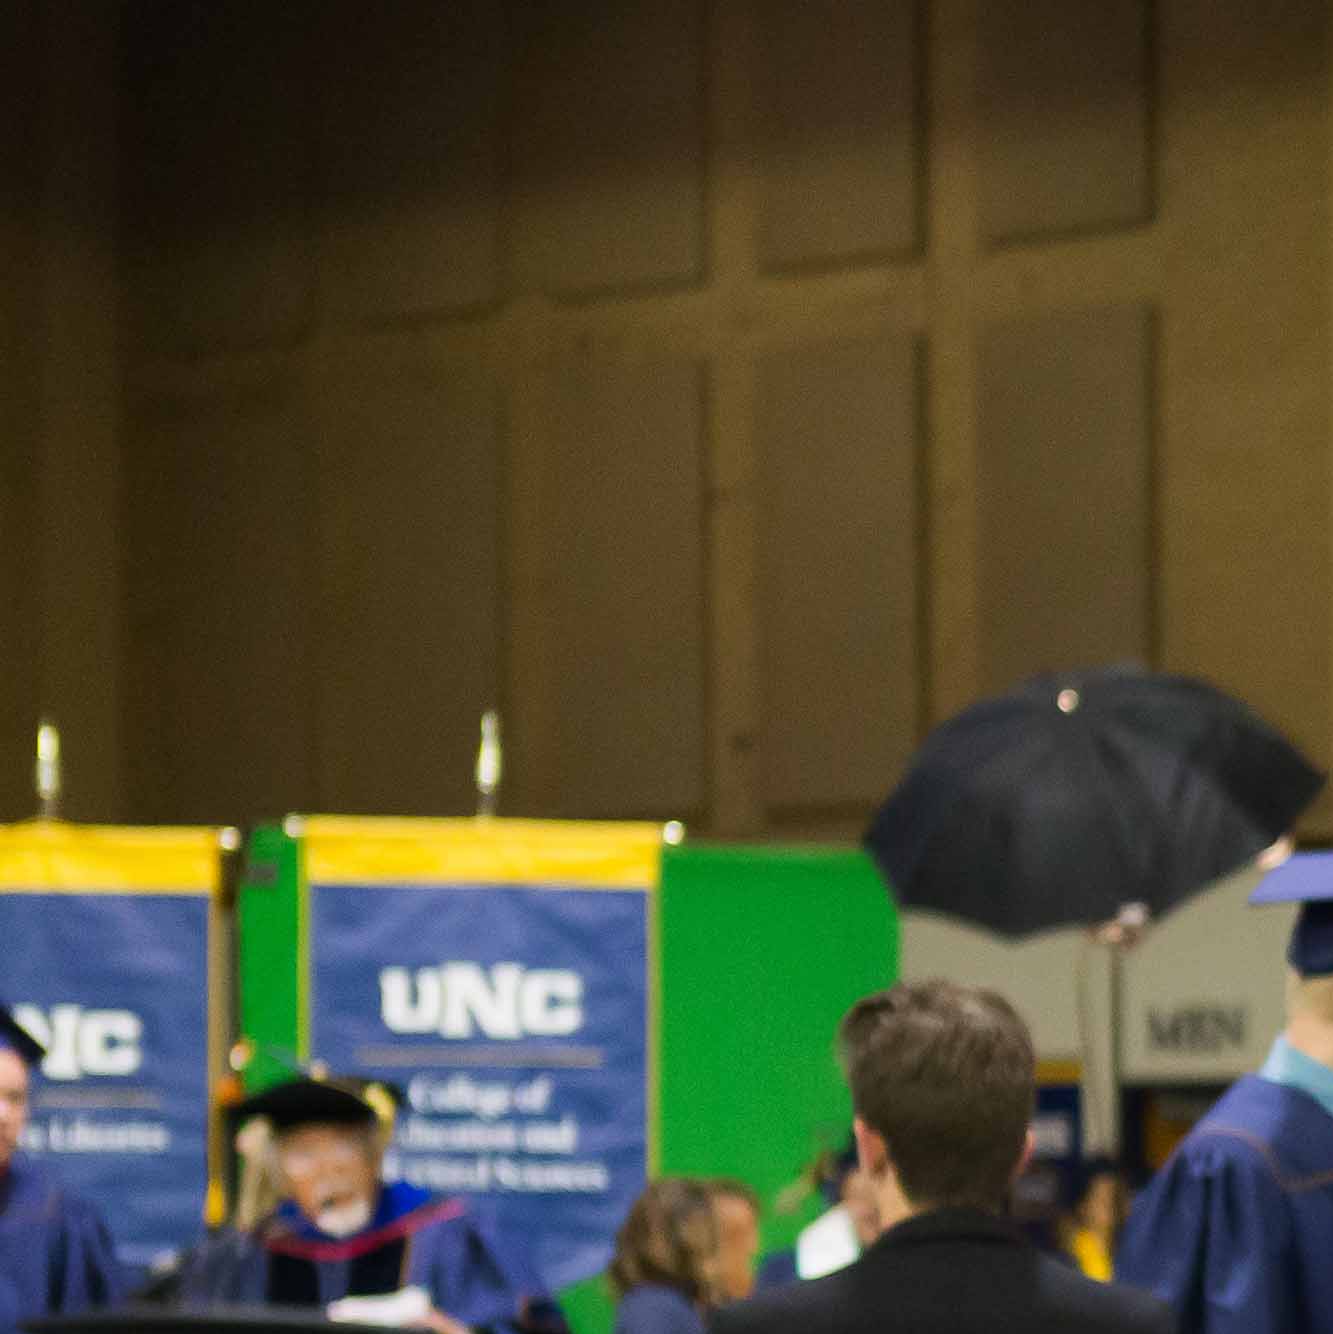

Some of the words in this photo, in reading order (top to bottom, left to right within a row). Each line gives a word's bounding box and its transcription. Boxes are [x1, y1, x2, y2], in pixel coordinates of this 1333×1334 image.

[379, 960, 584, 1040] UNC
[1147, 1006, 1247, 1050] MEN
[12, 1003, 143, 1080] NC
